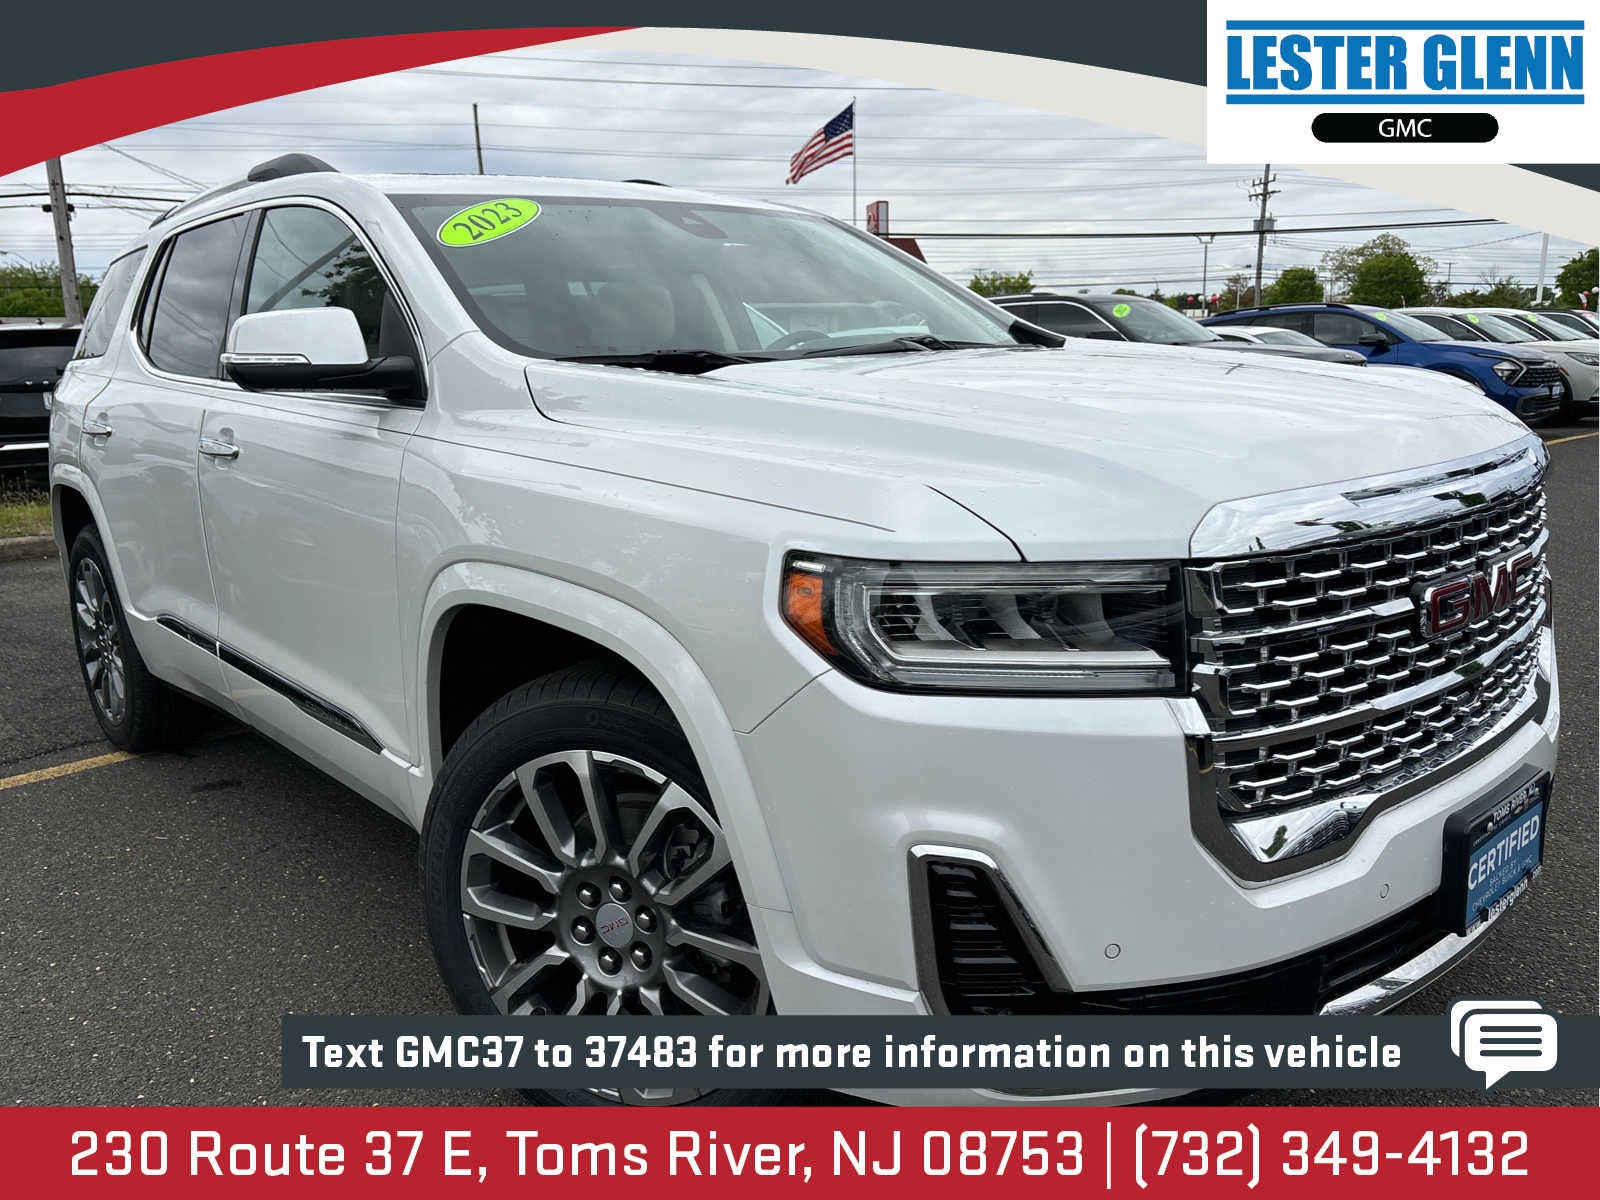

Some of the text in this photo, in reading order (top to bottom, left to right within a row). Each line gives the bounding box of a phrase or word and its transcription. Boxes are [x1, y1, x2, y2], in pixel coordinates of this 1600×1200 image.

[453, 202, 522, 240] 2023
[1424, 549, 1532, 637] GMC
[1468, 815, 1540, 890] CERTIFIED
[600, 916, 629, 934] GMC
